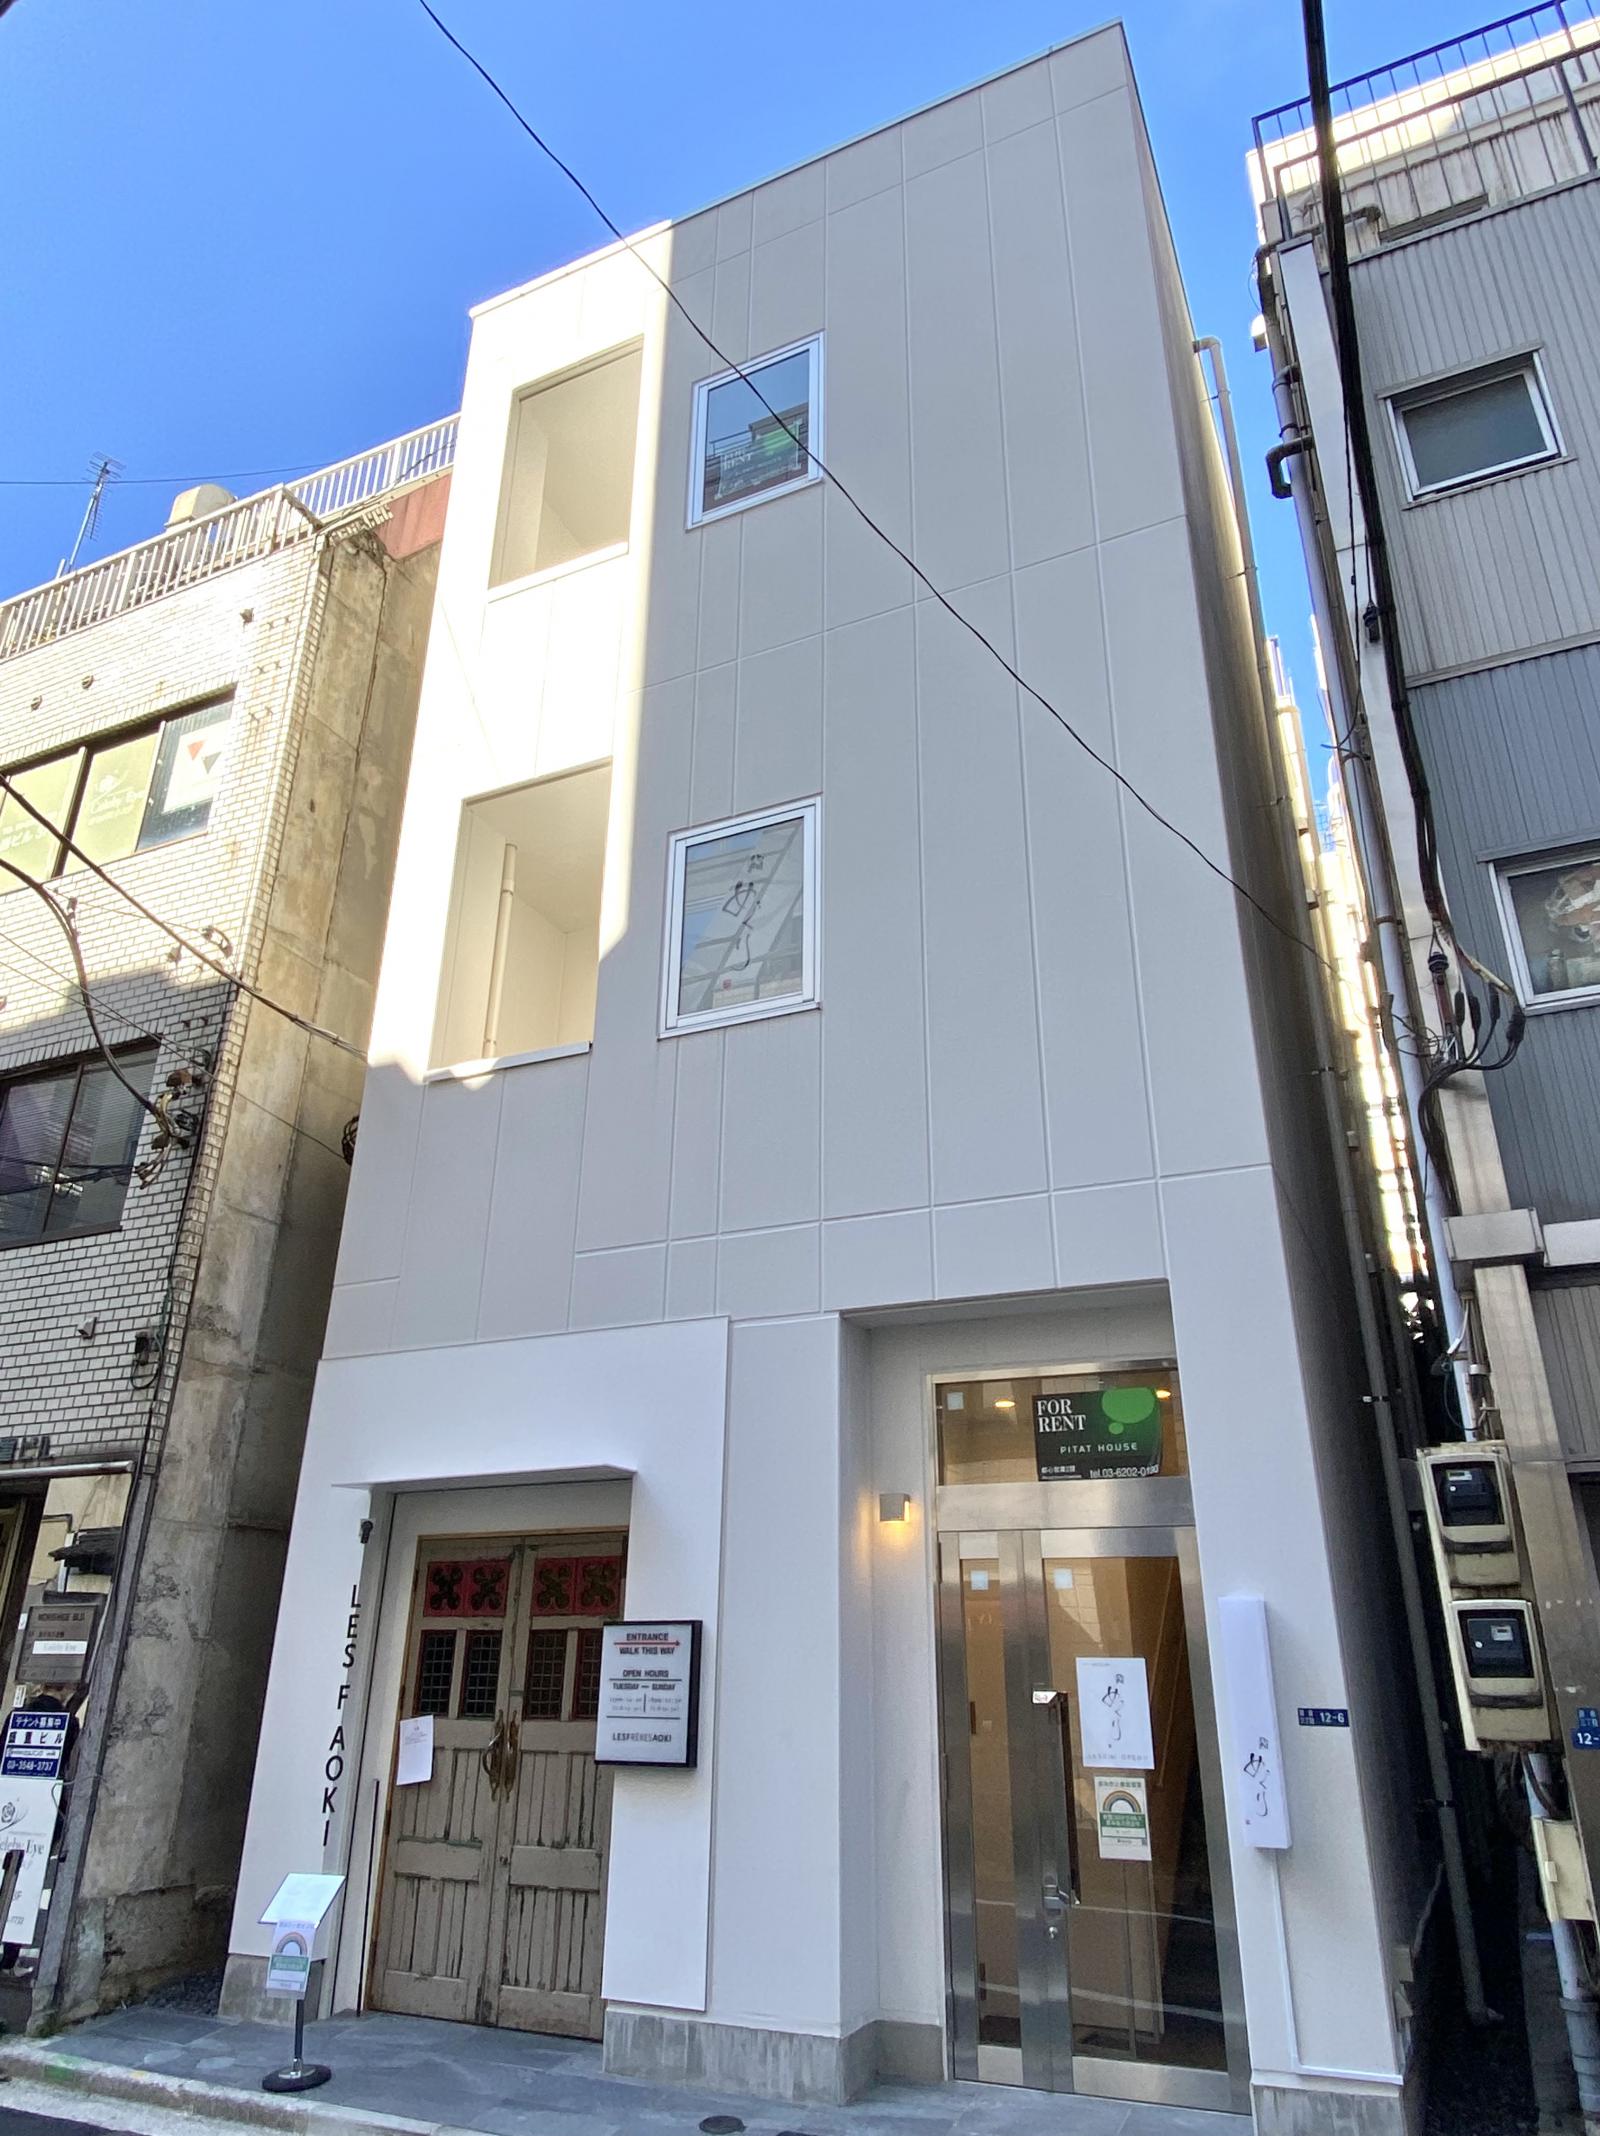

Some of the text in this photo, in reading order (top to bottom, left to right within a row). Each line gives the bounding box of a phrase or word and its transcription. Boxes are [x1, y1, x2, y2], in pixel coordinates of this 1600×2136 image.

[1037, 1398, 1073, 1416] FOR
[1039, 1414, 1087, 1433] RENT
[1060, 1442, 1138, 1455] PITAT HOUSE
[626, 1632, 669, 1641] ENTRANCE
[619, 1646, 676, 1655] WALK THIS WAY
[622, 1669, 669, 1678] OPEN HOURS
[613, 1682, 676, 1691] TUESDAY SUNDAY
[321, 1584, 362, 1847] LES F AOKI
[1319, 1711, 1345, 1723] 12-6
